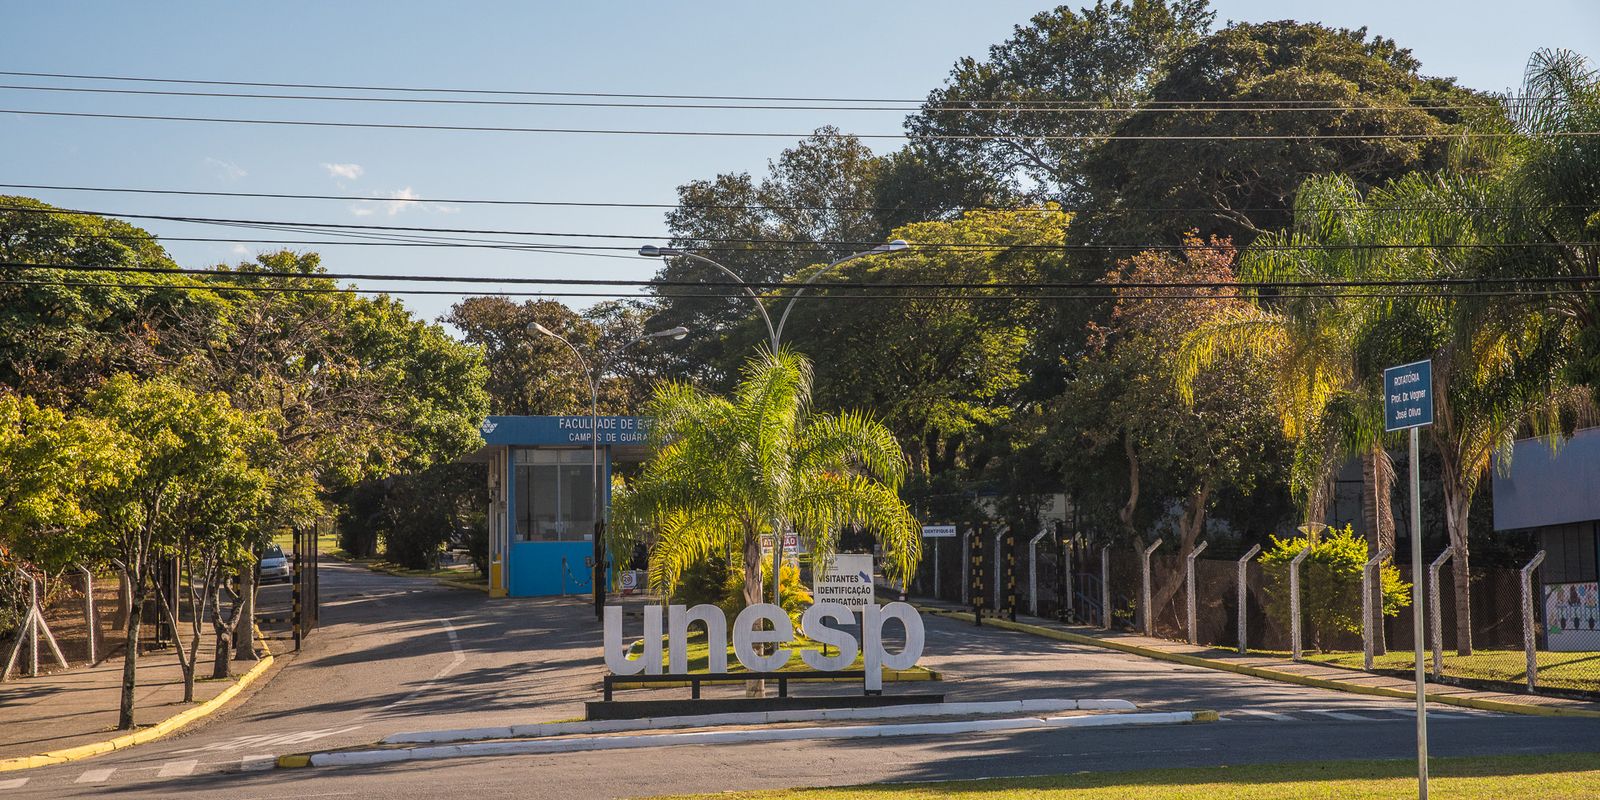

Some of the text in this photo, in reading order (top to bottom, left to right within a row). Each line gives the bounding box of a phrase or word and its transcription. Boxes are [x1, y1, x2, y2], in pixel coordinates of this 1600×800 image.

[1394, 371, 1420, 386] ROTATÓRIA
[1391, 393, 1402, 403] Prof.
[1395, 408, 1421, 419] José Oliva
[620, 418, 633, 430] DE
[606, 432, 617, 442] DE
[817, 585, 871, 596] IDENTIFICAÇÃO
[603, 601, 925, 692] unesp
